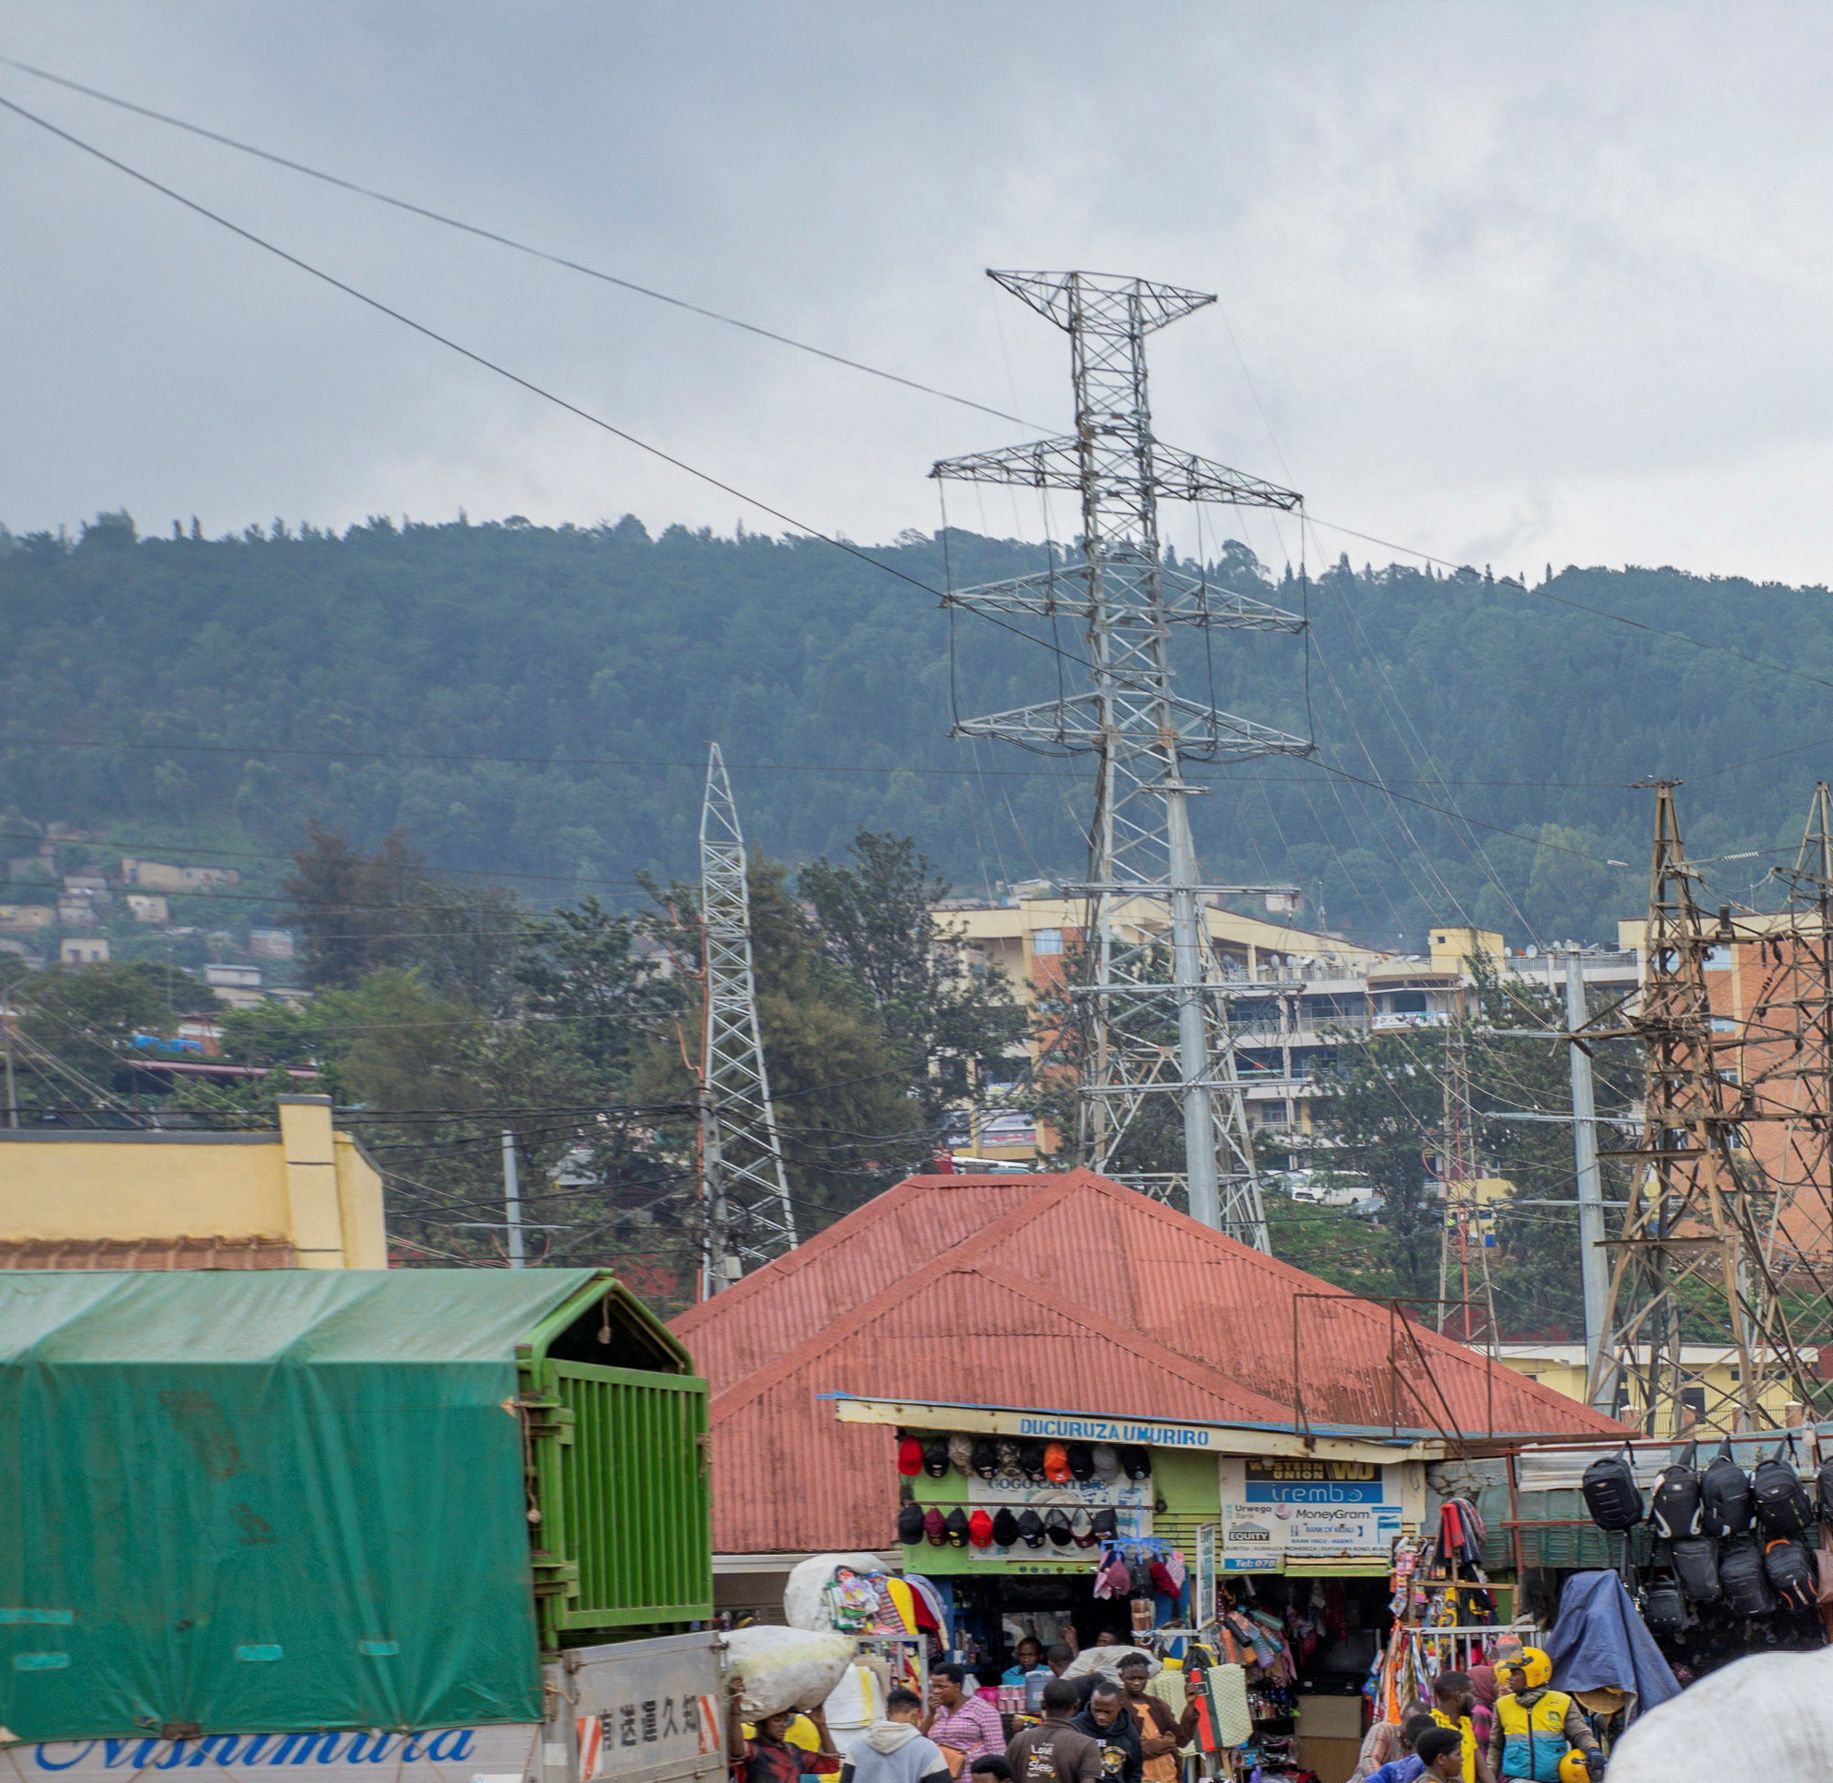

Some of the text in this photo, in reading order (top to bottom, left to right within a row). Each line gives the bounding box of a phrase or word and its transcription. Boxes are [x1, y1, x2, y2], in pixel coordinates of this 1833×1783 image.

[1019, 1418, 1210, 1446] DUCURUZA UMURIRO
[1273, 1471, 1324, 1479] UNION
[1234, 1504, 1273, 1514] Urwego
[1295, 1509, 1371, 1522] MoneyGram
[1229, 1532, 1270, 1541] EQUITY
[1235, 1559, 1255, 1569] Tel:
